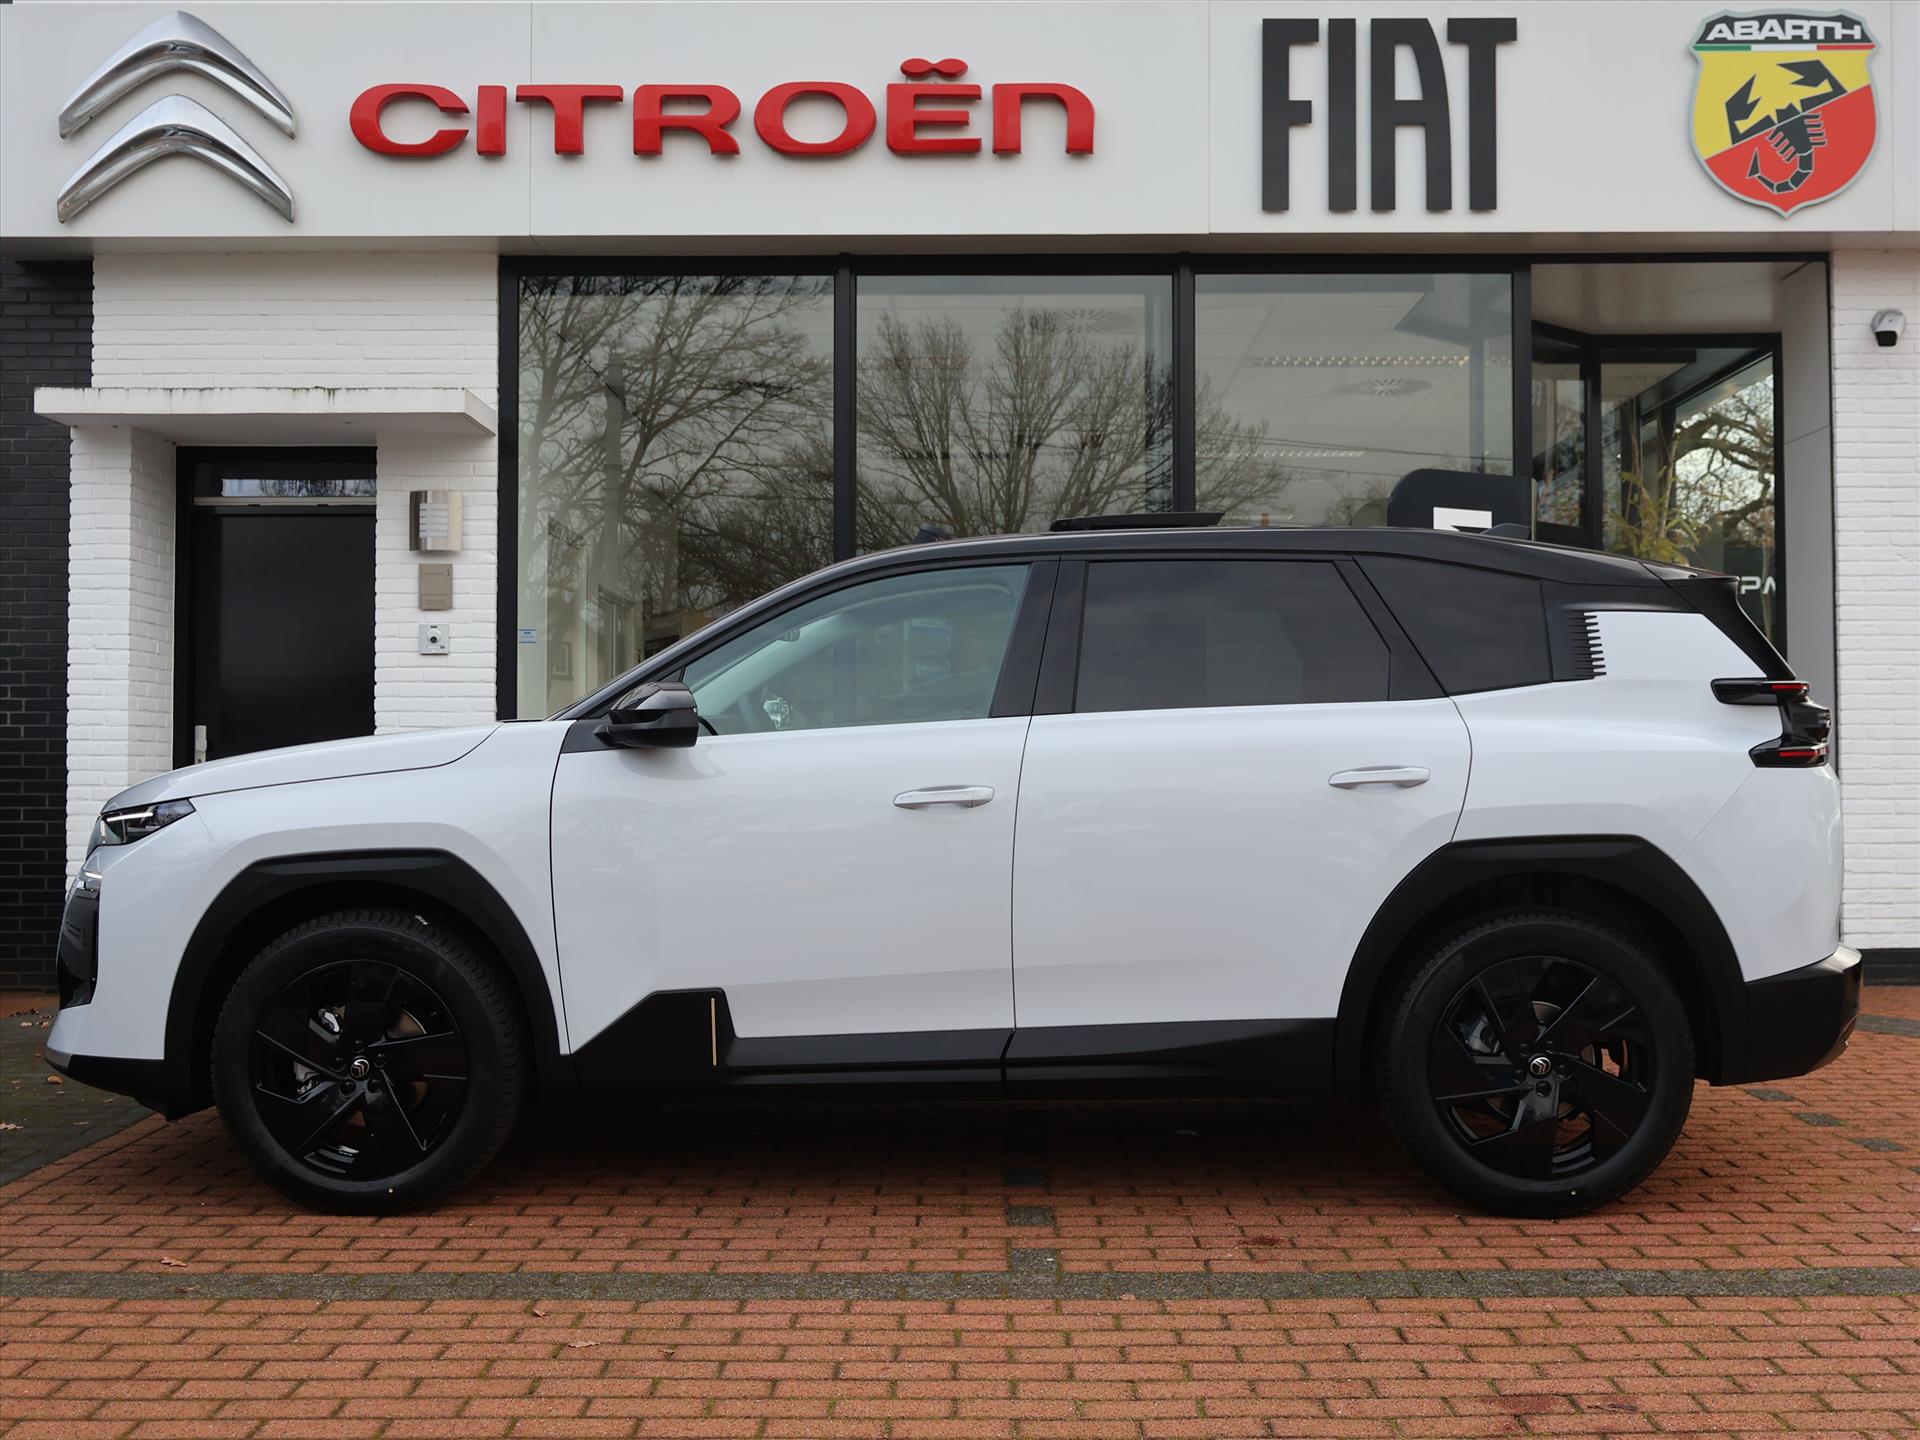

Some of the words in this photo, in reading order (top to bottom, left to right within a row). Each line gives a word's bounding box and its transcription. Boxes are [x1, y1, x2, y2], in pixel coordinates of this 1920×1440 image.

[1706, 18, 1862, 41] ABARTH
[349, 57, 1095, 158] CITROËN
[1262, 17, 1518, 212] FIAT
